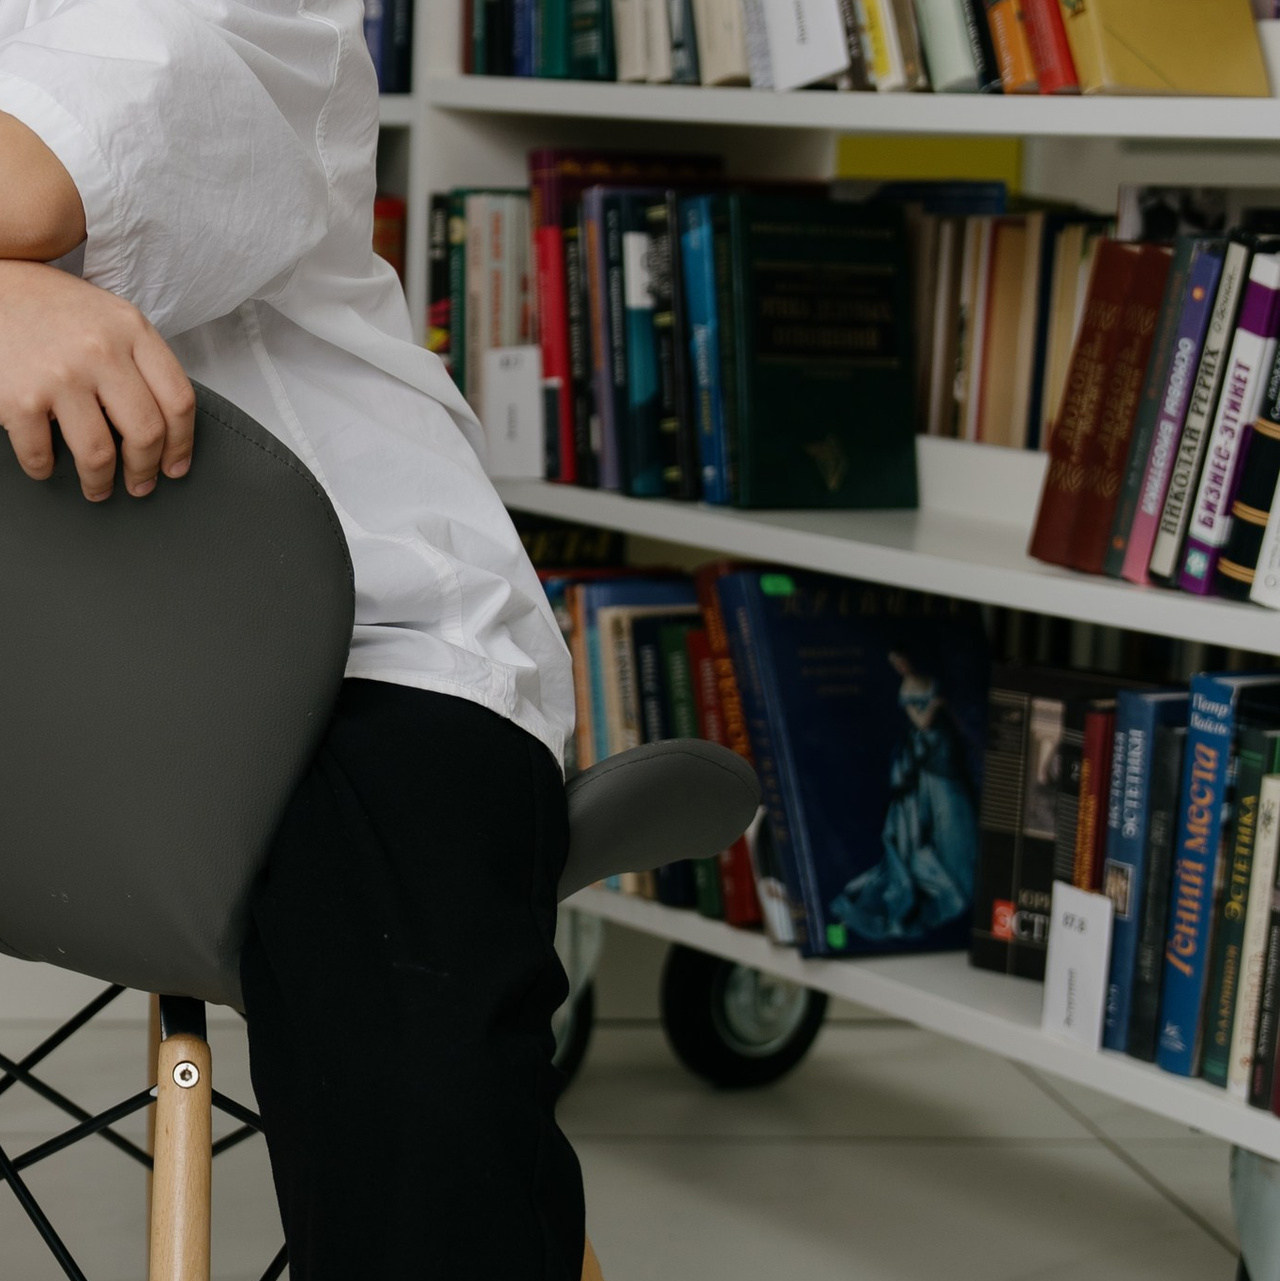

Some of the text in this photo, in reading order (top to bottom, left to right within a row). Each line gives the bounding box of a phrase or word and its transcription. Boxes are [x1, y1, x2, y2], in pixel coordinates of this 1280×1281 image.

[1160, 425, 1197, 537] НИКОЛАЙ
[1190, 343, 1223, 417] РЕРИХ
[1196, 356, 1255, 531] БИЗНЕС-ЭТИКЕТ
[1120, 727, 1146, 838] ЭСТЕТИКИ
[1163, 741, 1218, 977] Гений места
[1224, 791, 1257, 921] ЭСТЕТИКА
